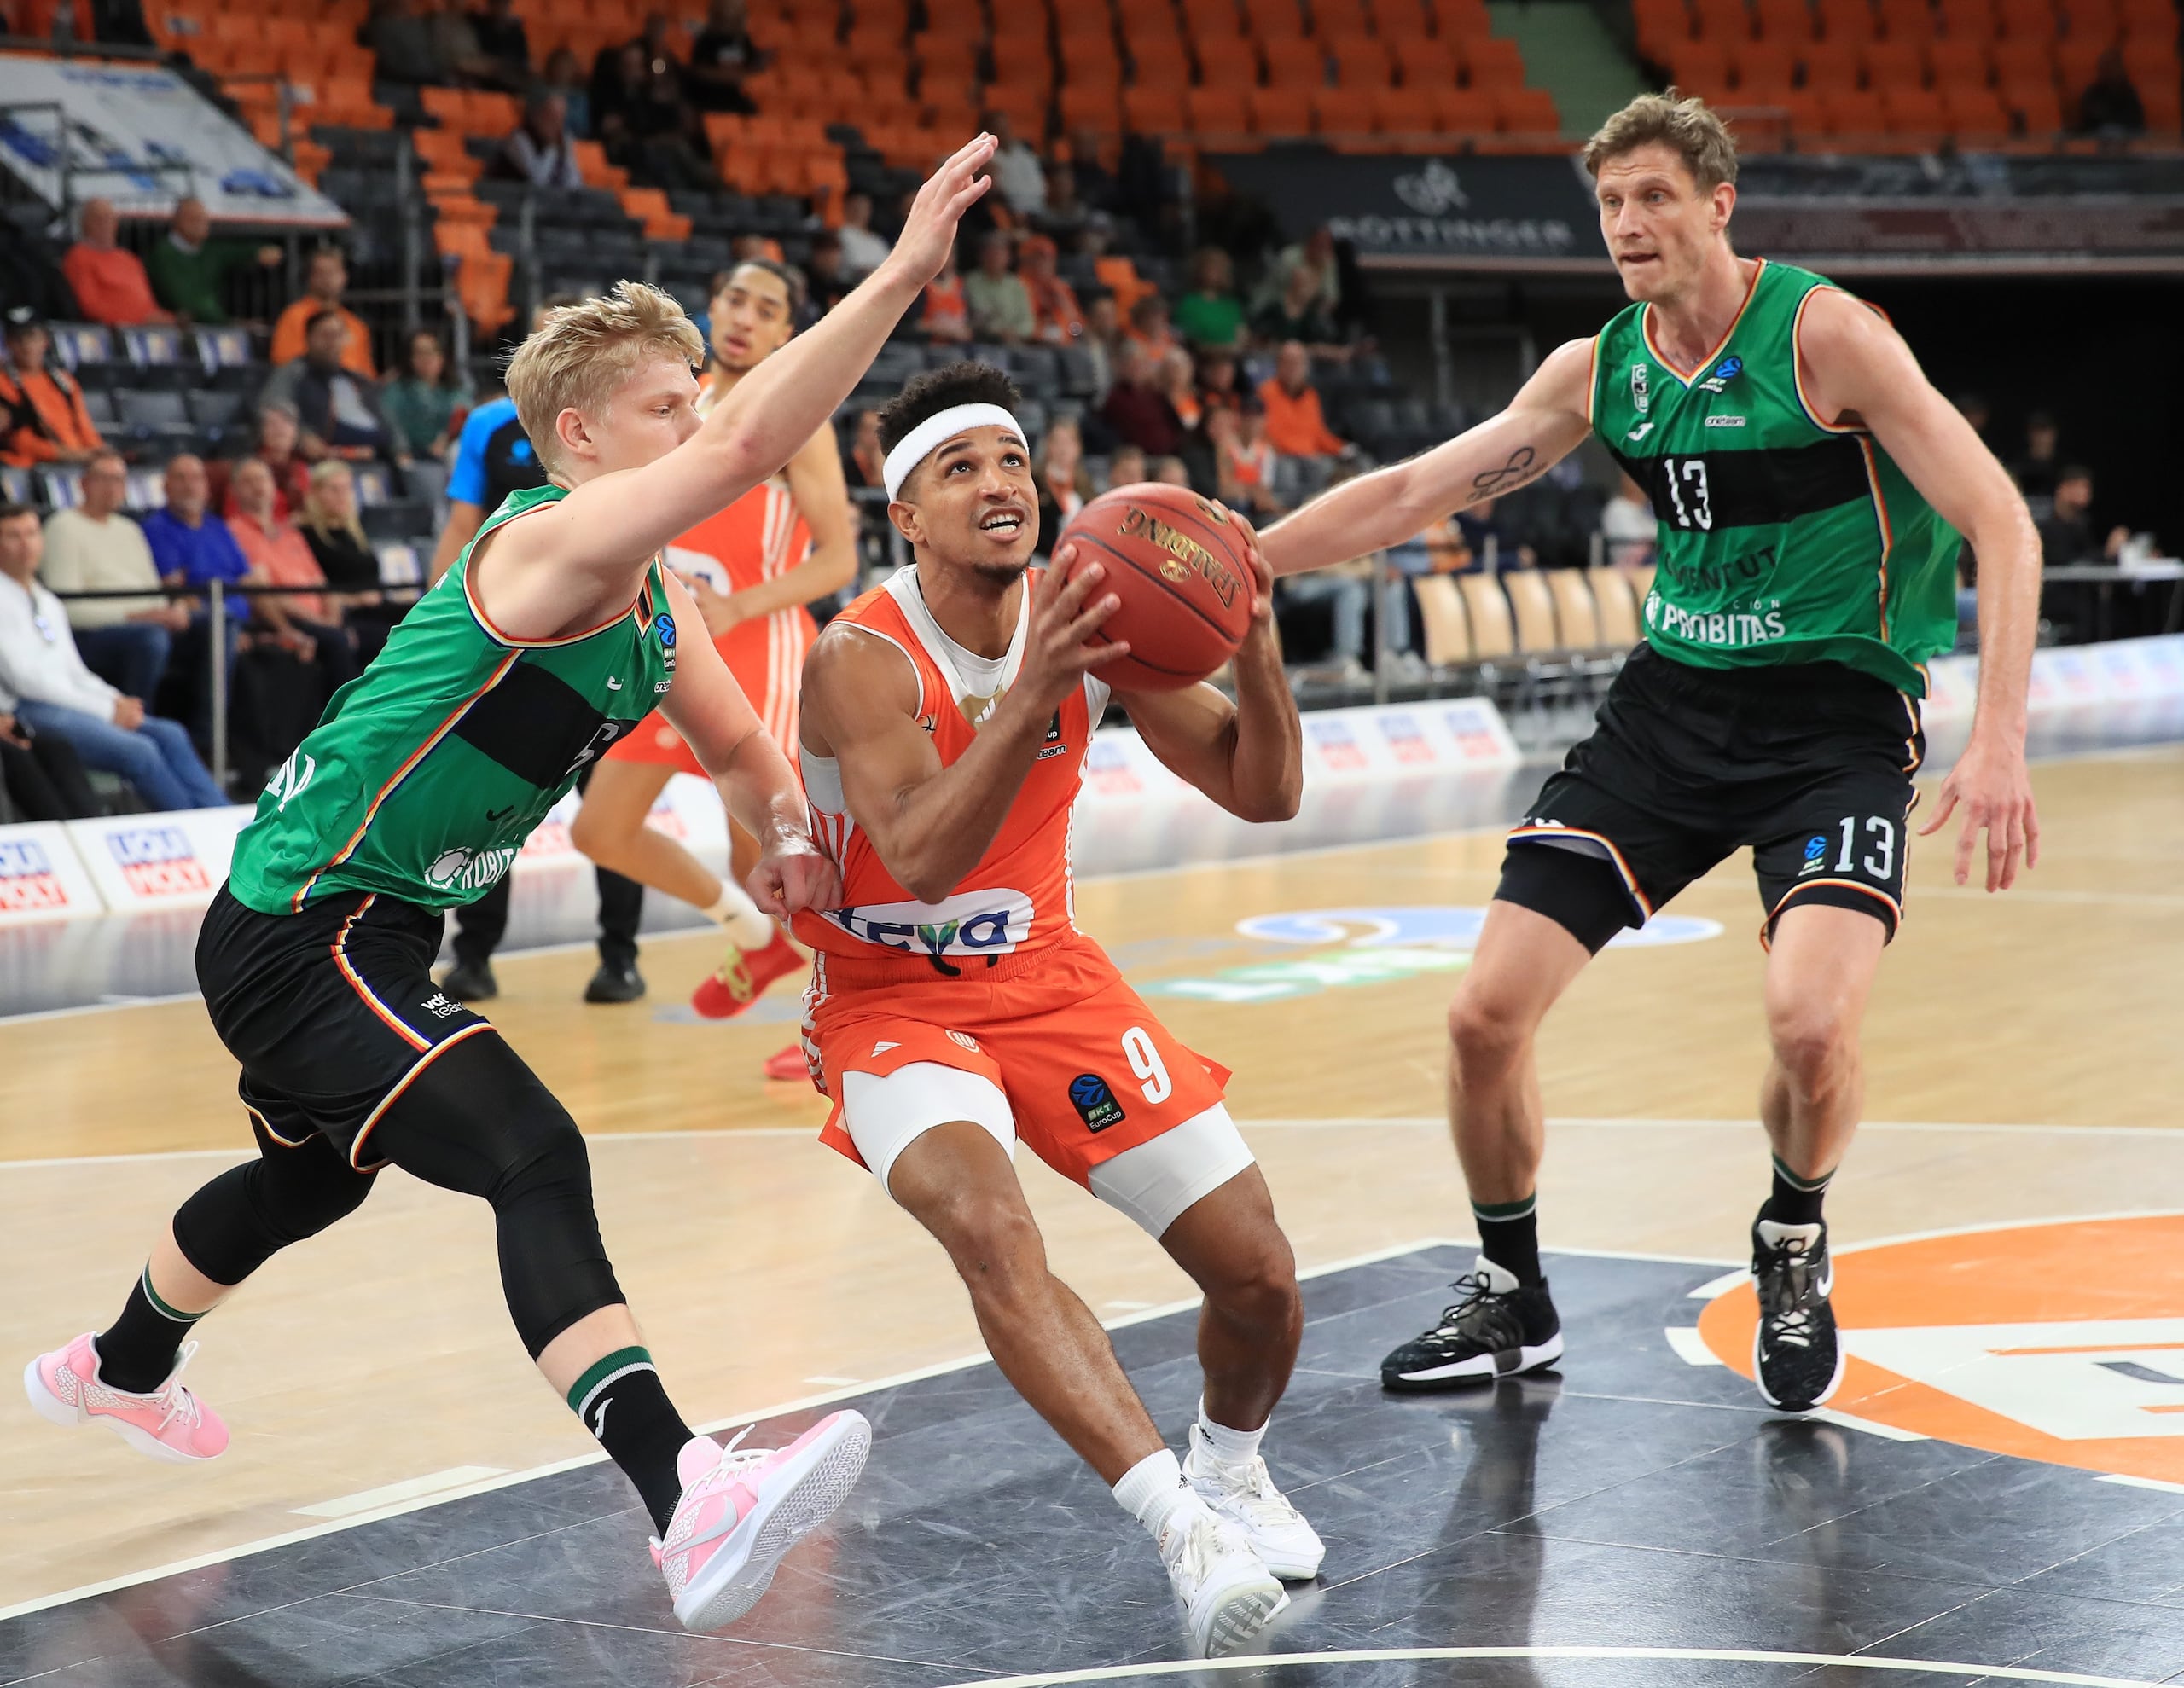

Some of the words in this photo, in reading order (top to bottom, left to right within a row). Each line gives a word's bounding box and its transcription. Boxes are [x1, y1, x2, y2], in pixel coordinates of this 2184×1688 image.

[1664, 458, 1712, 531] 13
[1117, 507, 1242, 609] SPALDING
[1662, 603, 1786, 646] PROBITAS
[1834, 816, 1895, 881] 13
[1121, 1026, 1173, 1105] 9
[1089, 1111, 1122, 1130] EuroCup
